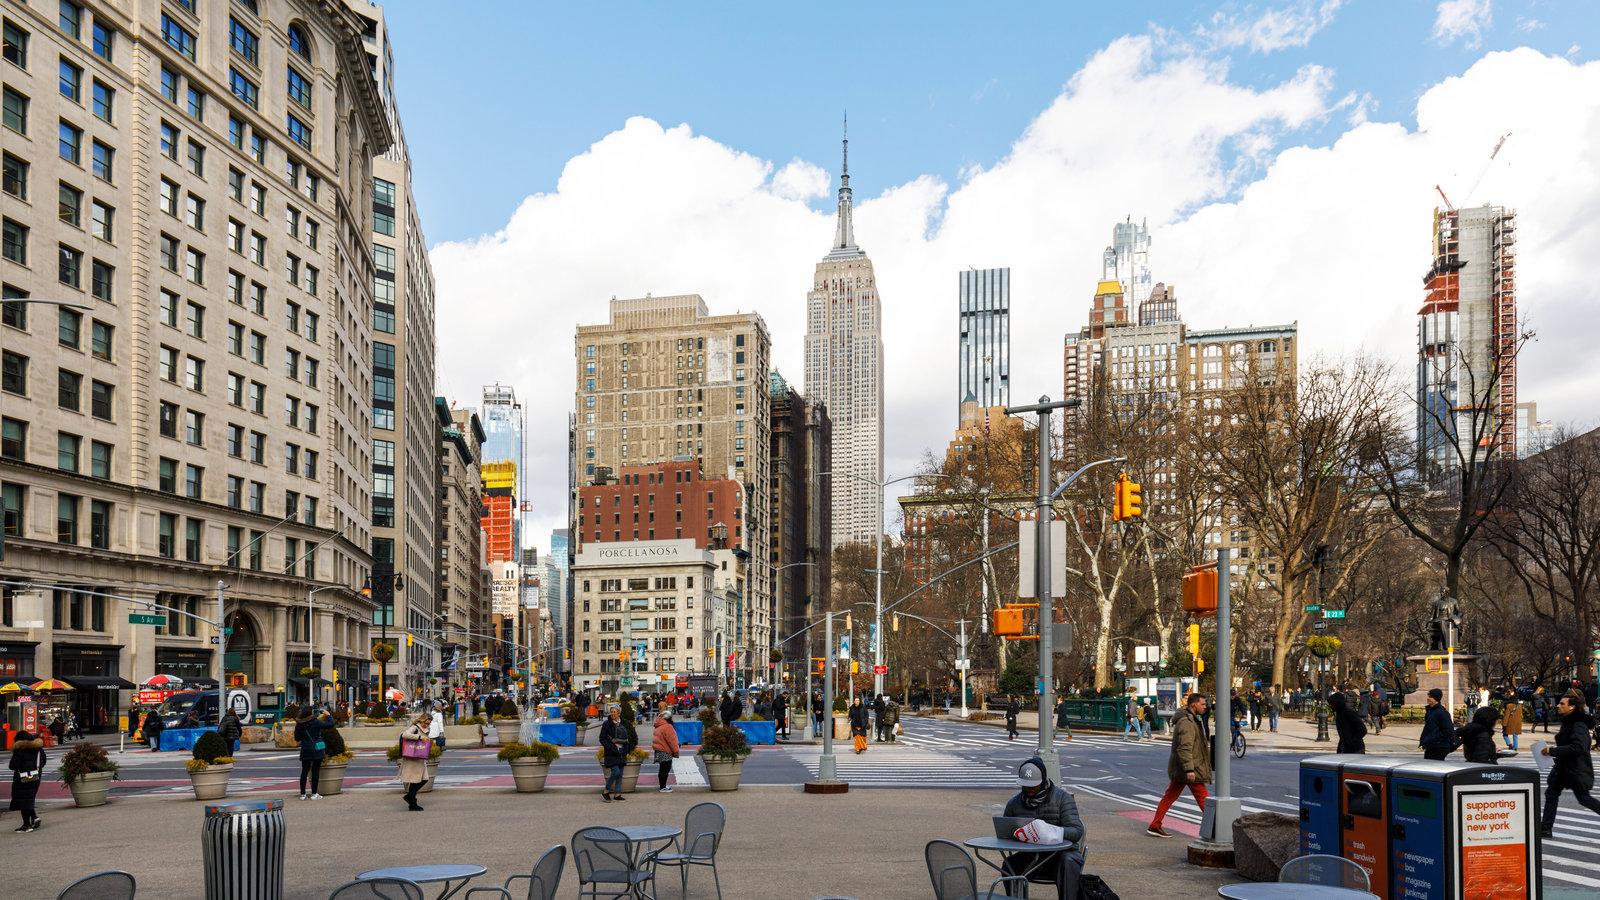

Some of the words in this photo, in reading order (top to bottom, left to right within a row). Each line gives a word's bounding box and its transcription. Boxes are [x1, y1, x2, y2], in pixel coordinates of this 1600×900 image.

[599, 547, 679, 558] PORCELANOSA
[1466, 800, 1516, 810] supporting
[1474, 811, 1510, 820] cleaner
[1466, 824, 1487, 832] new
[1489, 821, 1510, 833] york
[1404, 852, 1435, 866] newspaper
[1405, 863, 1415, 872] box
[1405, 876, 1432, 889] magazine
